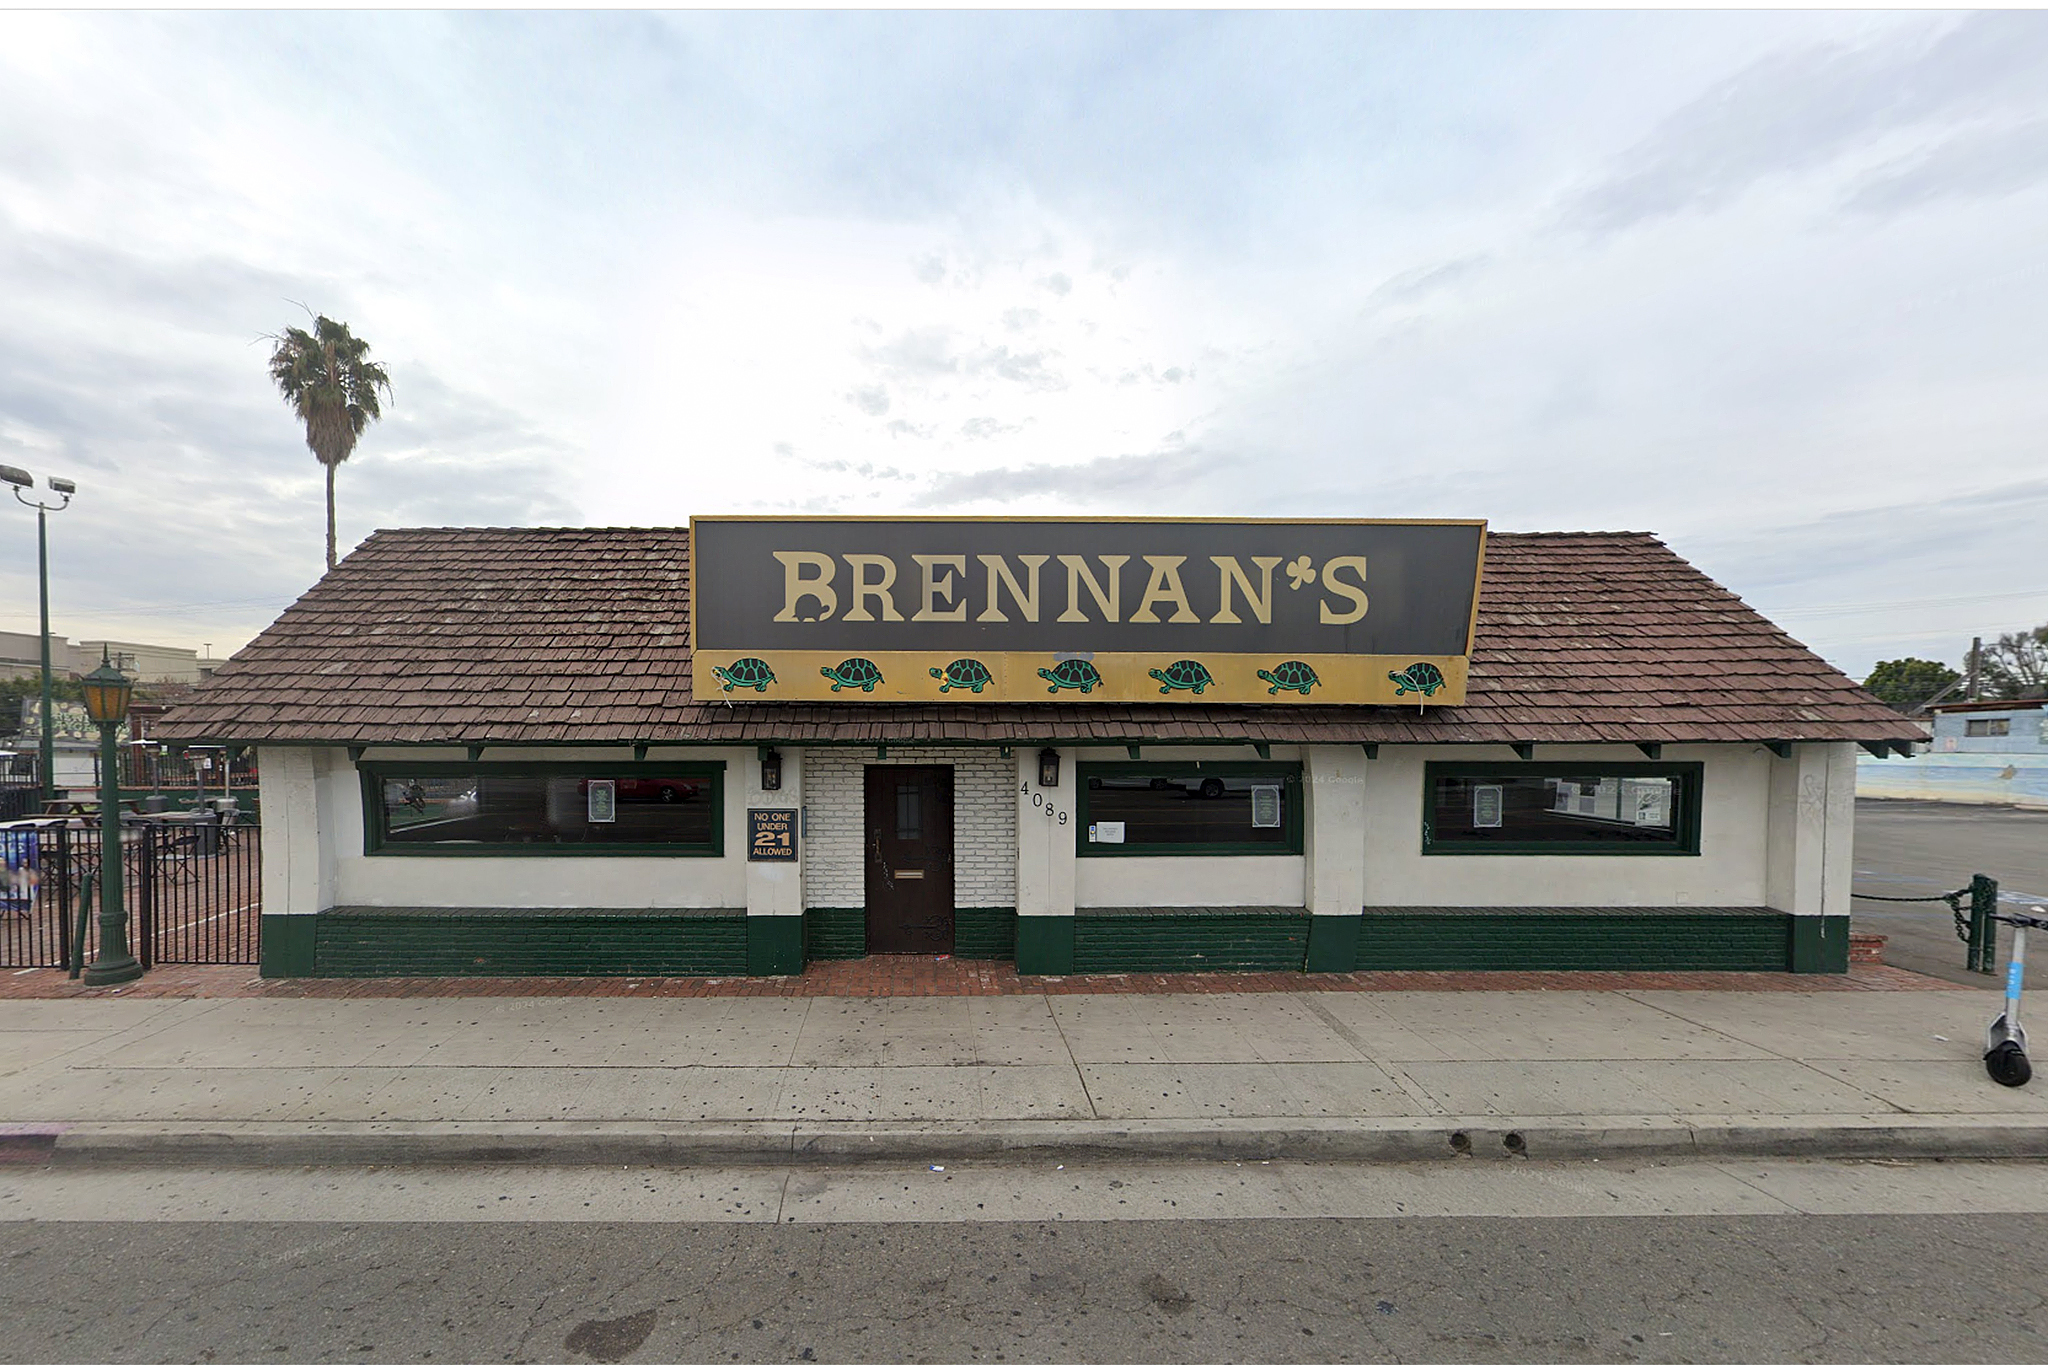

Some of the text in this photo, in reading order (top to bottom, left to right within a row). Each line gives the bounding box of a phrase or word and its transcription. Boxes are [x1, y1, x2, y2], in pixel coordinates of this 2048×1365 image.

[1020, 781, 1067, 825] 4089
[754, 813, 791, 821] NO ONE
[757, 822, 788, 831] UNDER
[754, 831, 790, 846] 21
[753, 847, 793, 856] ALLOWED
